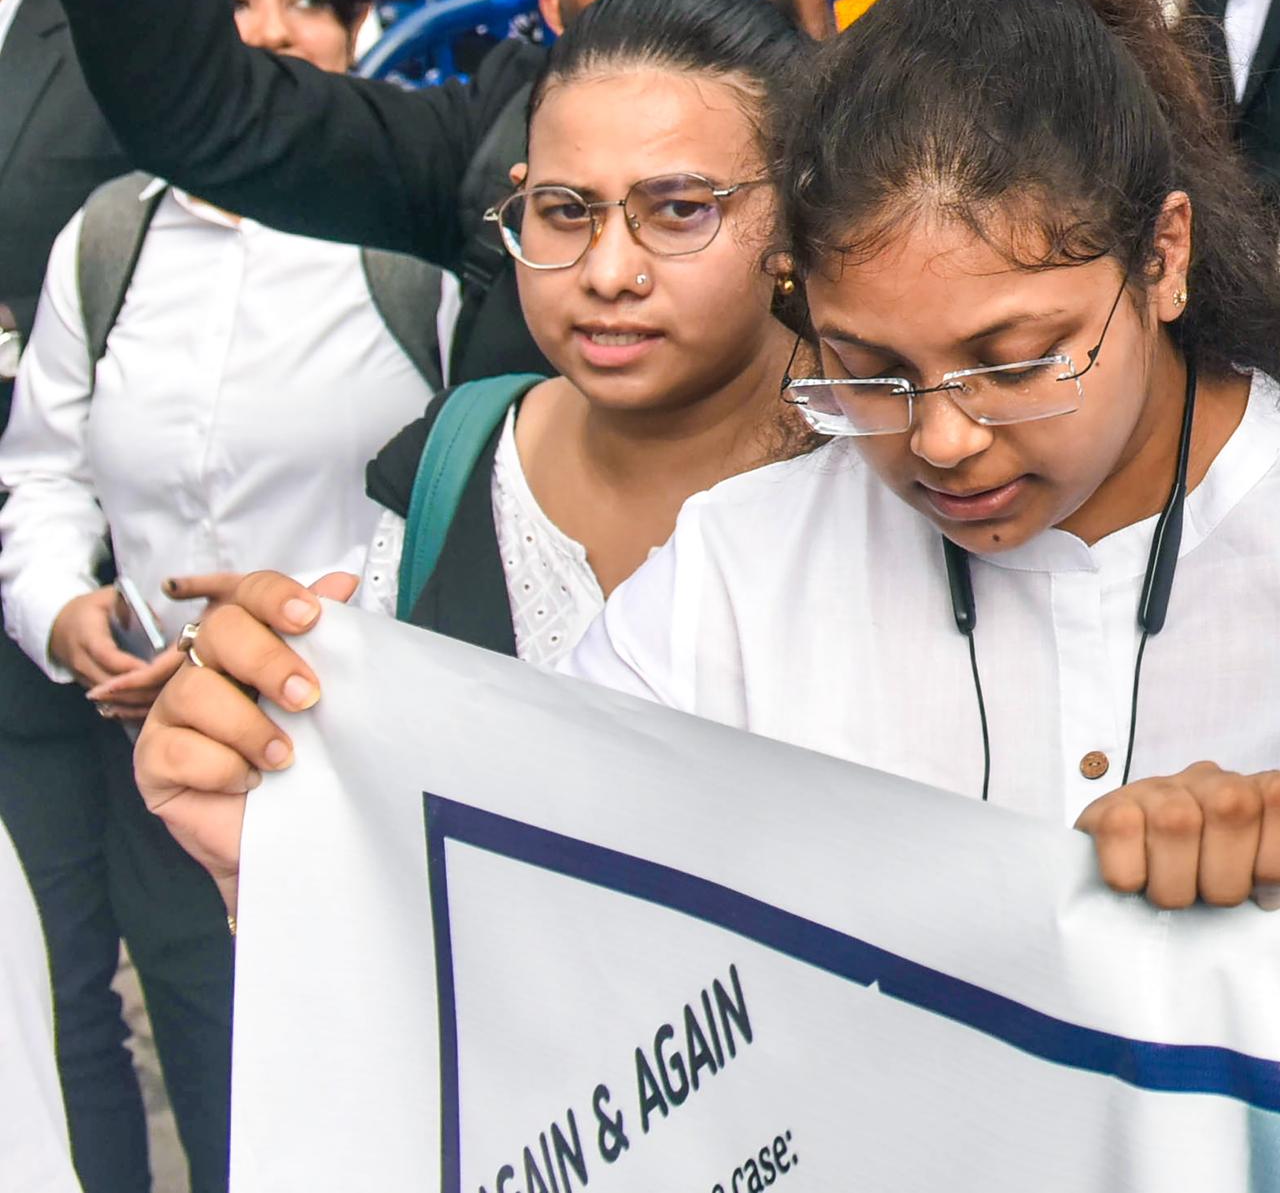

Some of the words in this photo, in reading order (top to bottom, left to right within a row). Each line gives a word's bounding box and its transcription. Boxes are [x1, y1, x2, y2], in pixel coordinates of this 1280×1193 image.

[478, 1107, 589, 1193] AIN
[593, 1083, 630, 1164] &
[635, 962, 753, 1135] AGAIN
